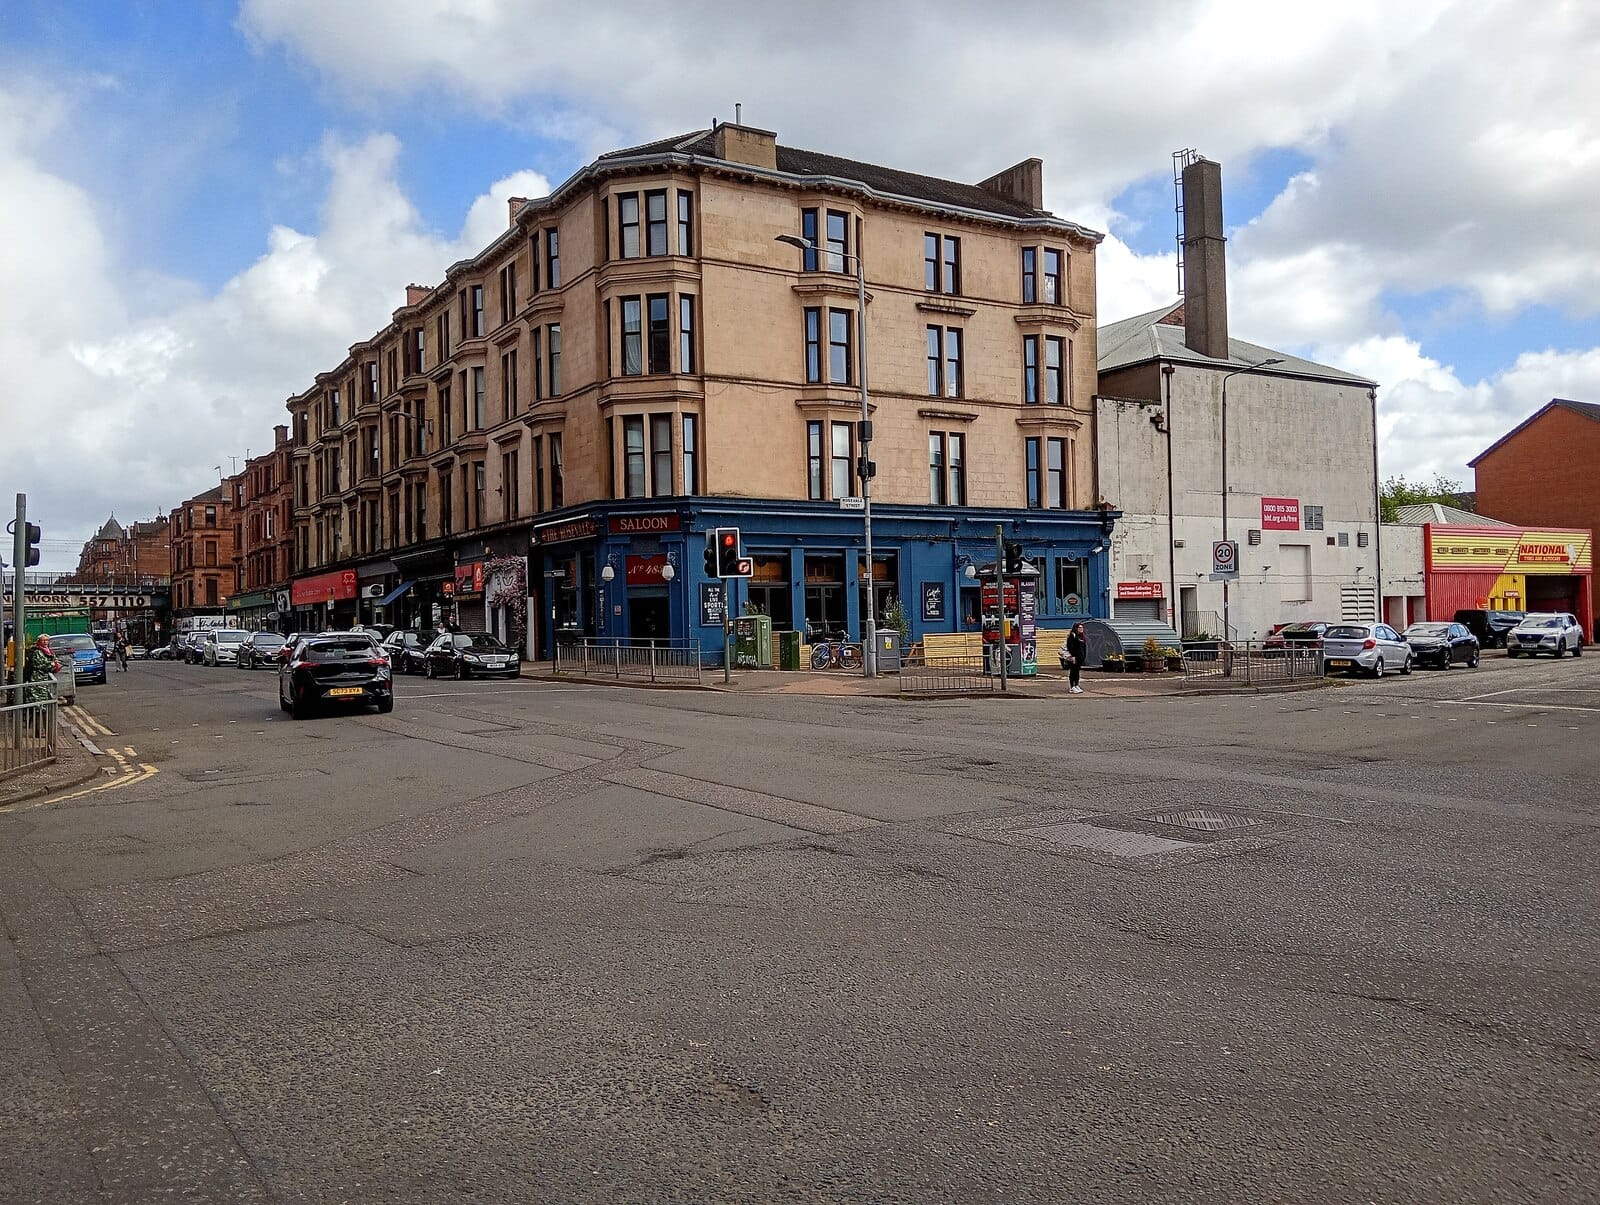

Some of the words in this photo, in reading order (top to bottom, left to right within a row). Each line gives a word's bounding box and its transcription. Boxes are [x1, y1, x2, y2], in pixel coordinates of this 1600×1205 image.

[620, 517, 668, 530] SALOON
[1218, 548, 1230, 558] 20
[1520, 545, 1566, 554] NATIONAL
[80, 596, 106, 606] 557
[114, 596, 144, 606] 1110
